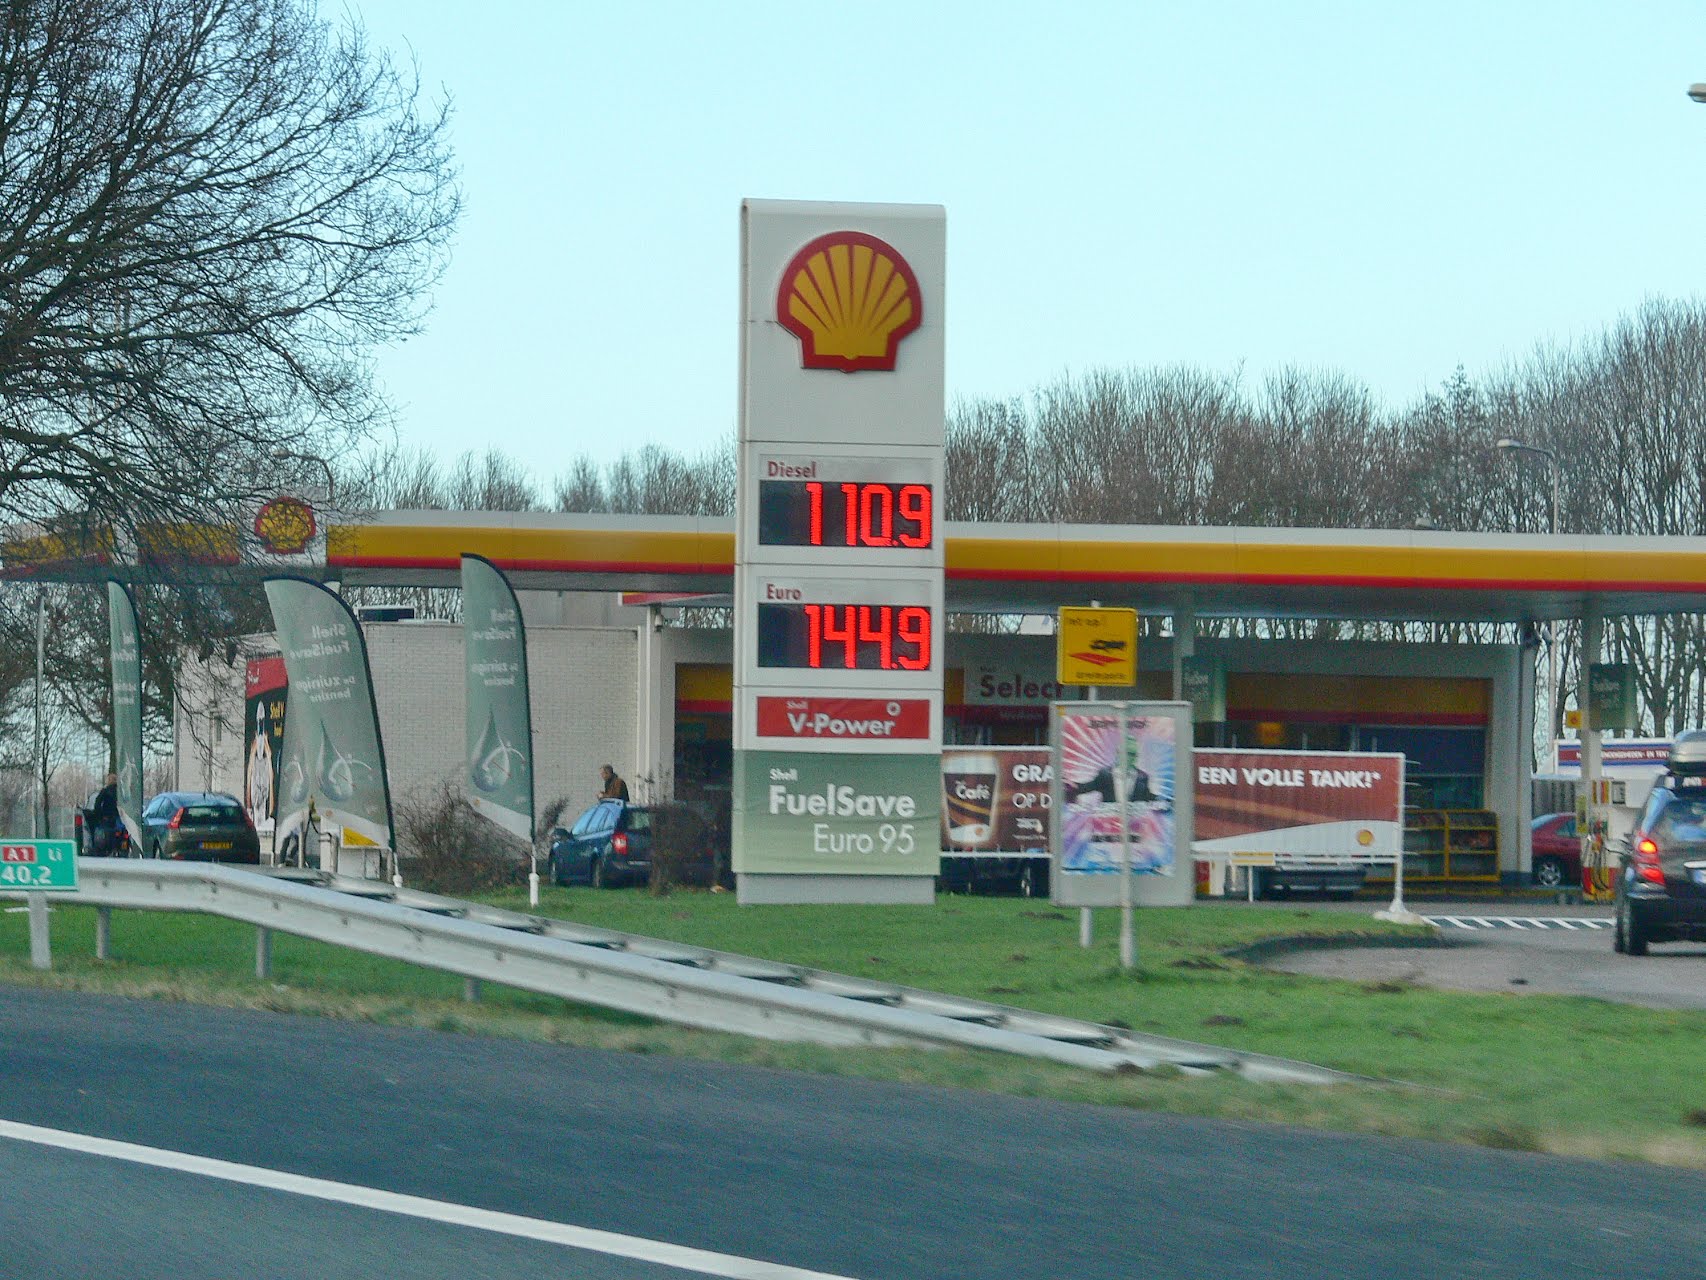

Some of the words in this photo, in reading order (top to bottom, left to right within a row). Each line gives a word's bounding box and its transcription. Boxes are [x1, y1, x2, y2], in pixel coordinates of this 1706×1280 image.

[767, 461, 817, 479] Diesel
[766, 583, 802, 601] Euro
[803, 604, 932, 671] 144.9
[787, 712, 896, 736] V-Power
[769, 768, 799, 781] Shell
[1198, 766, 1238, 786] EEN
[1241, 767, 1305, 787] VOLLE
[769, 783, 916, 818] FuelSave
[1012, 792, 1036, 809] OP
[813, 823, 874, 855] Euro
[878, 823, 915, 855] 95
[6, 846, 31, 862] A1
